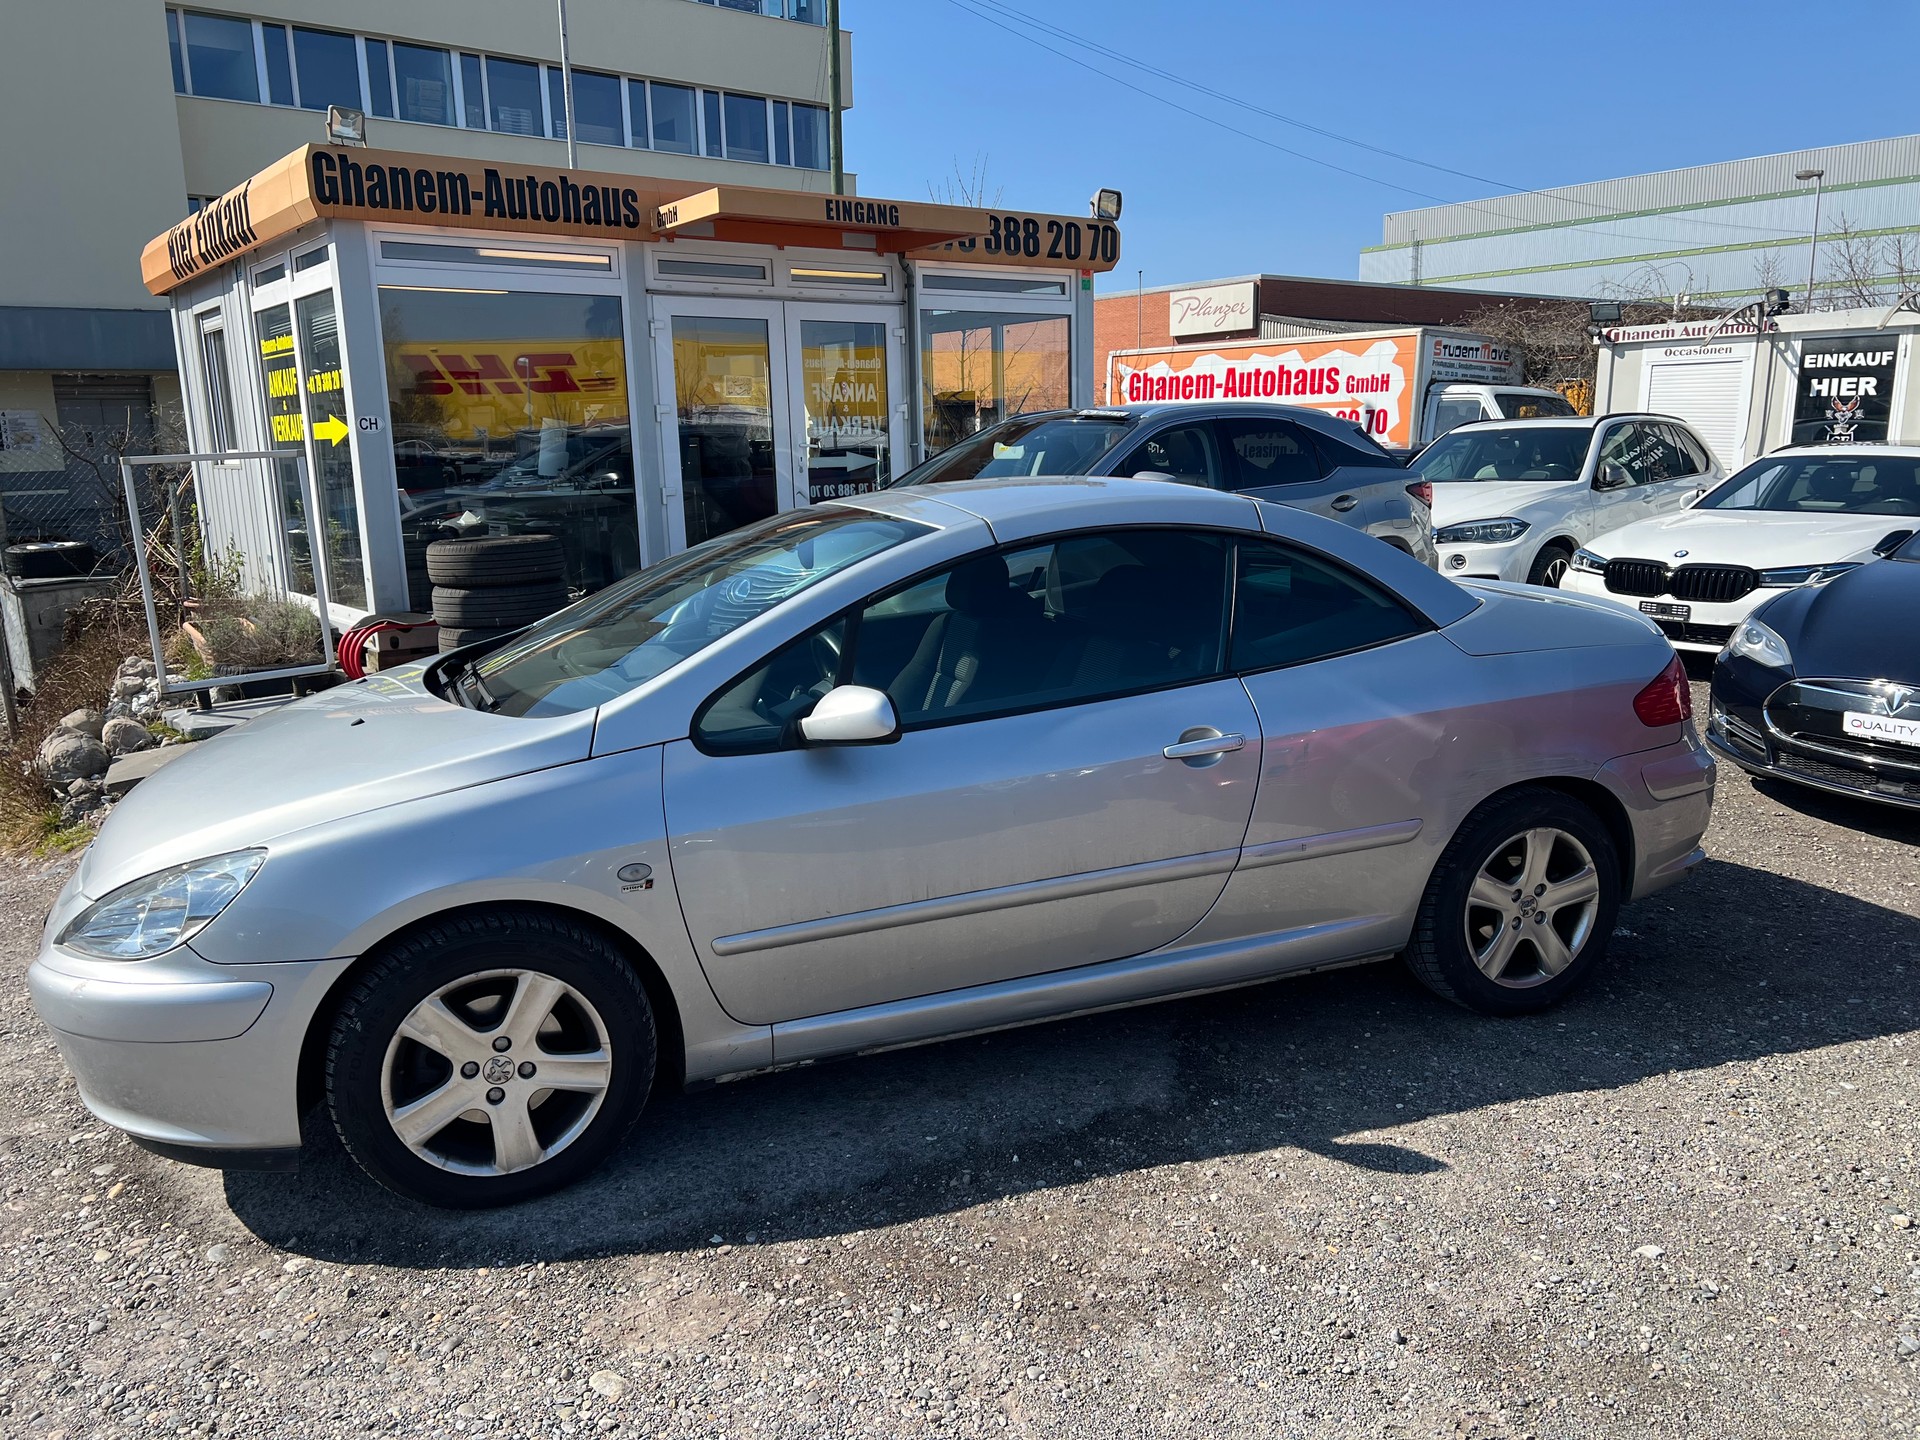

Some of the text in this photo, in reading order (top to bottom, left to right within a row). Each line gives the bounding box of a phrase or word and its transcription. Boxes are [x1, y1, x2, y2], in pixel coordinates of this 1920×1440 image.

[312, 150, 678, 229] Ghanem-Autohaus GmbH
[826, 199, 900, 226] EINGANG
[167, 179, 258, 280] Hier Einkauf
[984, 214, 1040, 257] 388
[1047, 220, 1081, 260] 20
[1086, 223, 1117, 262] 70
[1172, 296, 1250, 327] Planzer
[1605, 320, 1779, 344] Ghanem Autmoble
[1663, 345, 1733, 357] Occasionen
[1803, 351, 1895, 369] EINKAUF
[268, 367, 298, 398] ANKAUF
[1128, 364, 1391, 402] Ghanem-Autohaus GmbH
[1809, 376, 1878, 397] HIER
[270, 413, 305, 442] VERKAUF
[359, 418, 378, 430] CH
[1366, 408, 1388, 435] 70
[1850, 718, 1918, 736] QUALITY
